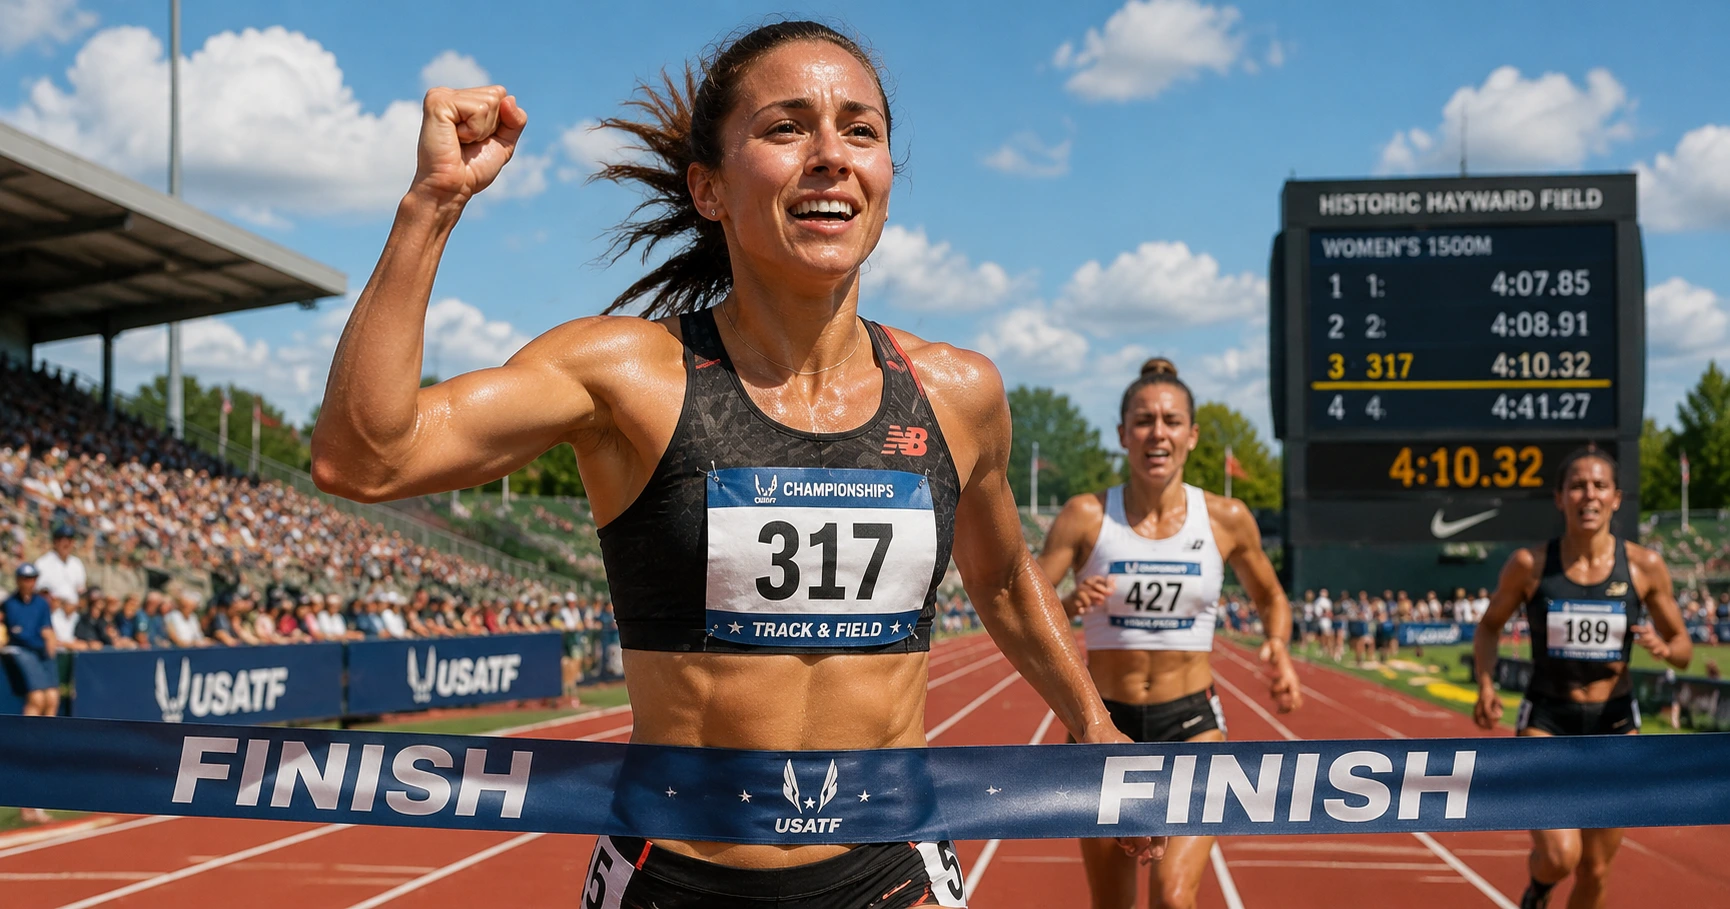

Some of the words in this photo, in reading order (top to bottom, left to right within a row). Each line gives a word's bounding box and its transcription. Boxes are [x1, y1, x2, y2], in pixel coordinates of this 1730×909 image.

[1319, 192, 1421, 216] HISTORIC
[1426, 189, 1535, 214] HAYWARD
[1540, 188, 1603, 210] FIELD
[1321, 236, 1421, 258] WOMEN'S
[1427, 235, 1492, 257] 1500M
[1328, 273, 1343, 299] 1
[1490, 269, 1591, 297] 4:07.85
[1327, 313, 1345, 339] 2
[1490, 310, 1589, 337] 4:08.91
[1327, 353, 1345, 380] 3
[1366, 352, 1414, 380] 317
[1491, 351, 1591, 378] 4:10.32
[1327, 394, 1345, 420] 4
[1491, 392, 1591, 420] 4:41.27
[1388, 446, 1544, 488] 4:10.32
[783, 482, 894, 498] CHAMPIONSHIPS
[755, 520, 894, 601] 317
[1124, 581, 1183, 612] 427
[752, 622, 813, 638] TRACK
[817, 622, 831, 638] &
[835, 622, 883, 638] FIELD
[1563, 619, 1609, 644] 189
[437, 654, 522, 698] USATF
[189, 666, 289, 717] USATF
[172, 736, 534, 819] FINISH
[1097, 750, 1477, 825] FINISH
[775, 818, 843, 833] USATF
[937, 841, 964, 901] 5
